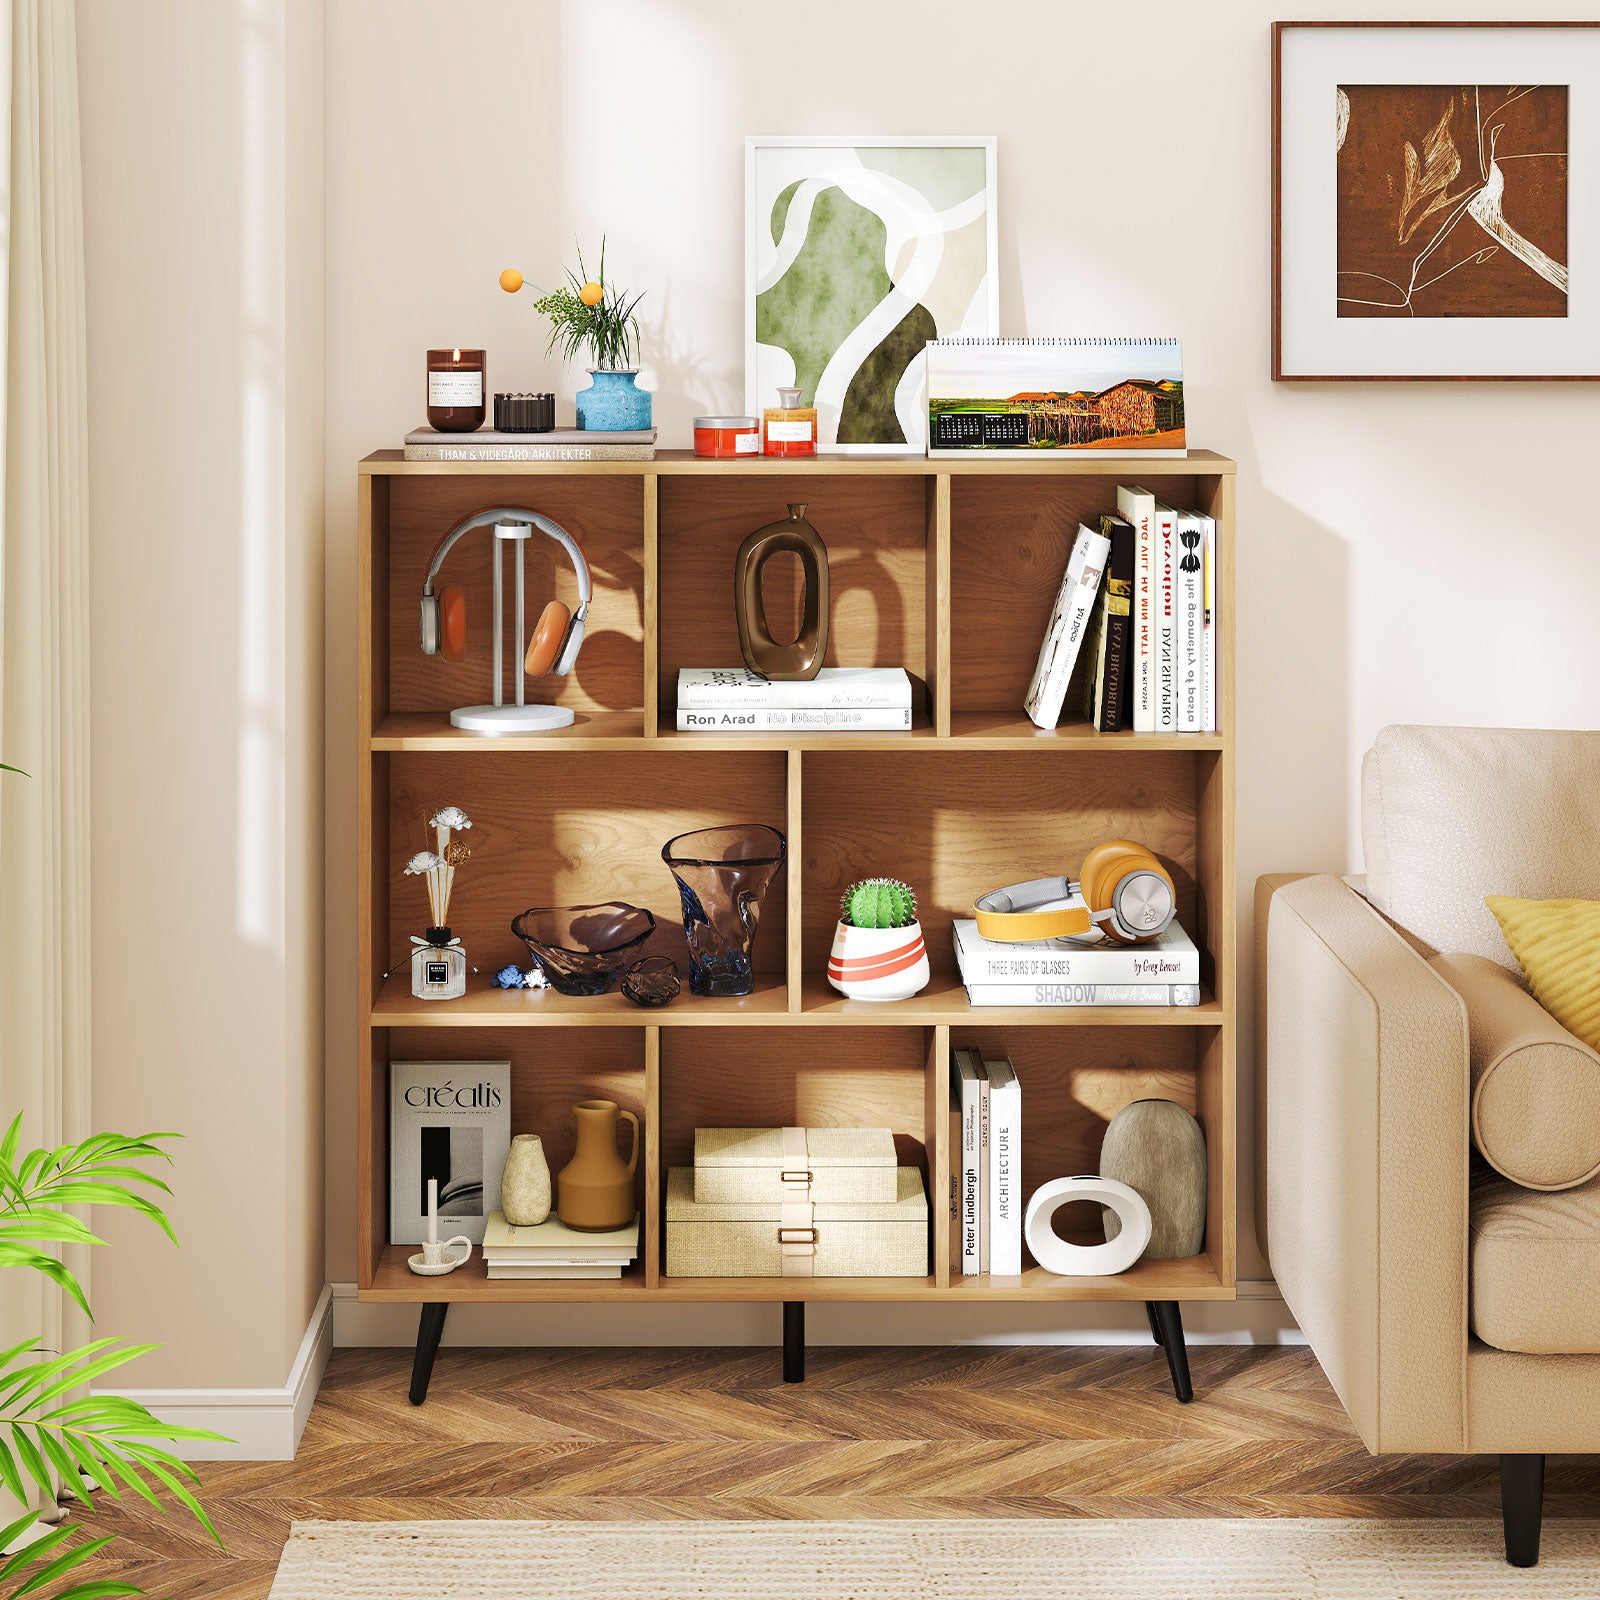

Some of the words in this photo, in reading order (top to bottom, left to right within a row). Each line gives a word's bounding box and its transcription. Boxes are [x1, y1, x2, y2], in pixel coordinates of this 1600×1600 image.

[439, 449, 467, 460] THAM
[470, 449, 477, 460] &
[479, 447, 529, 460] VIDEGÅRD
[686, 714, 716, 724] Ron
[721, 714, 756, 724] Arad
[767, 714, 787, 724] No
[792, 713, 862, 726] Discipline
[988, 960, 1008, 975] THREE
[1010, 960, 1029, 975] PAIRS
[1030, 960, 1040, 975] OF
[1040, 960, 1070, 975] GLASSES
[1134, 959, 1141, 976] by
[1142, 958, 1158, 976] Greg
[1036, 985, 1096, 1003] SHADOW
[404, 1080, 501, 1108] créatis
[1000, 1127, 1008, 1220] ARCHITECTURE
[966, 1168, 977, 1224] Lindbergh
[966, 1225, 974, 1256] Peter
